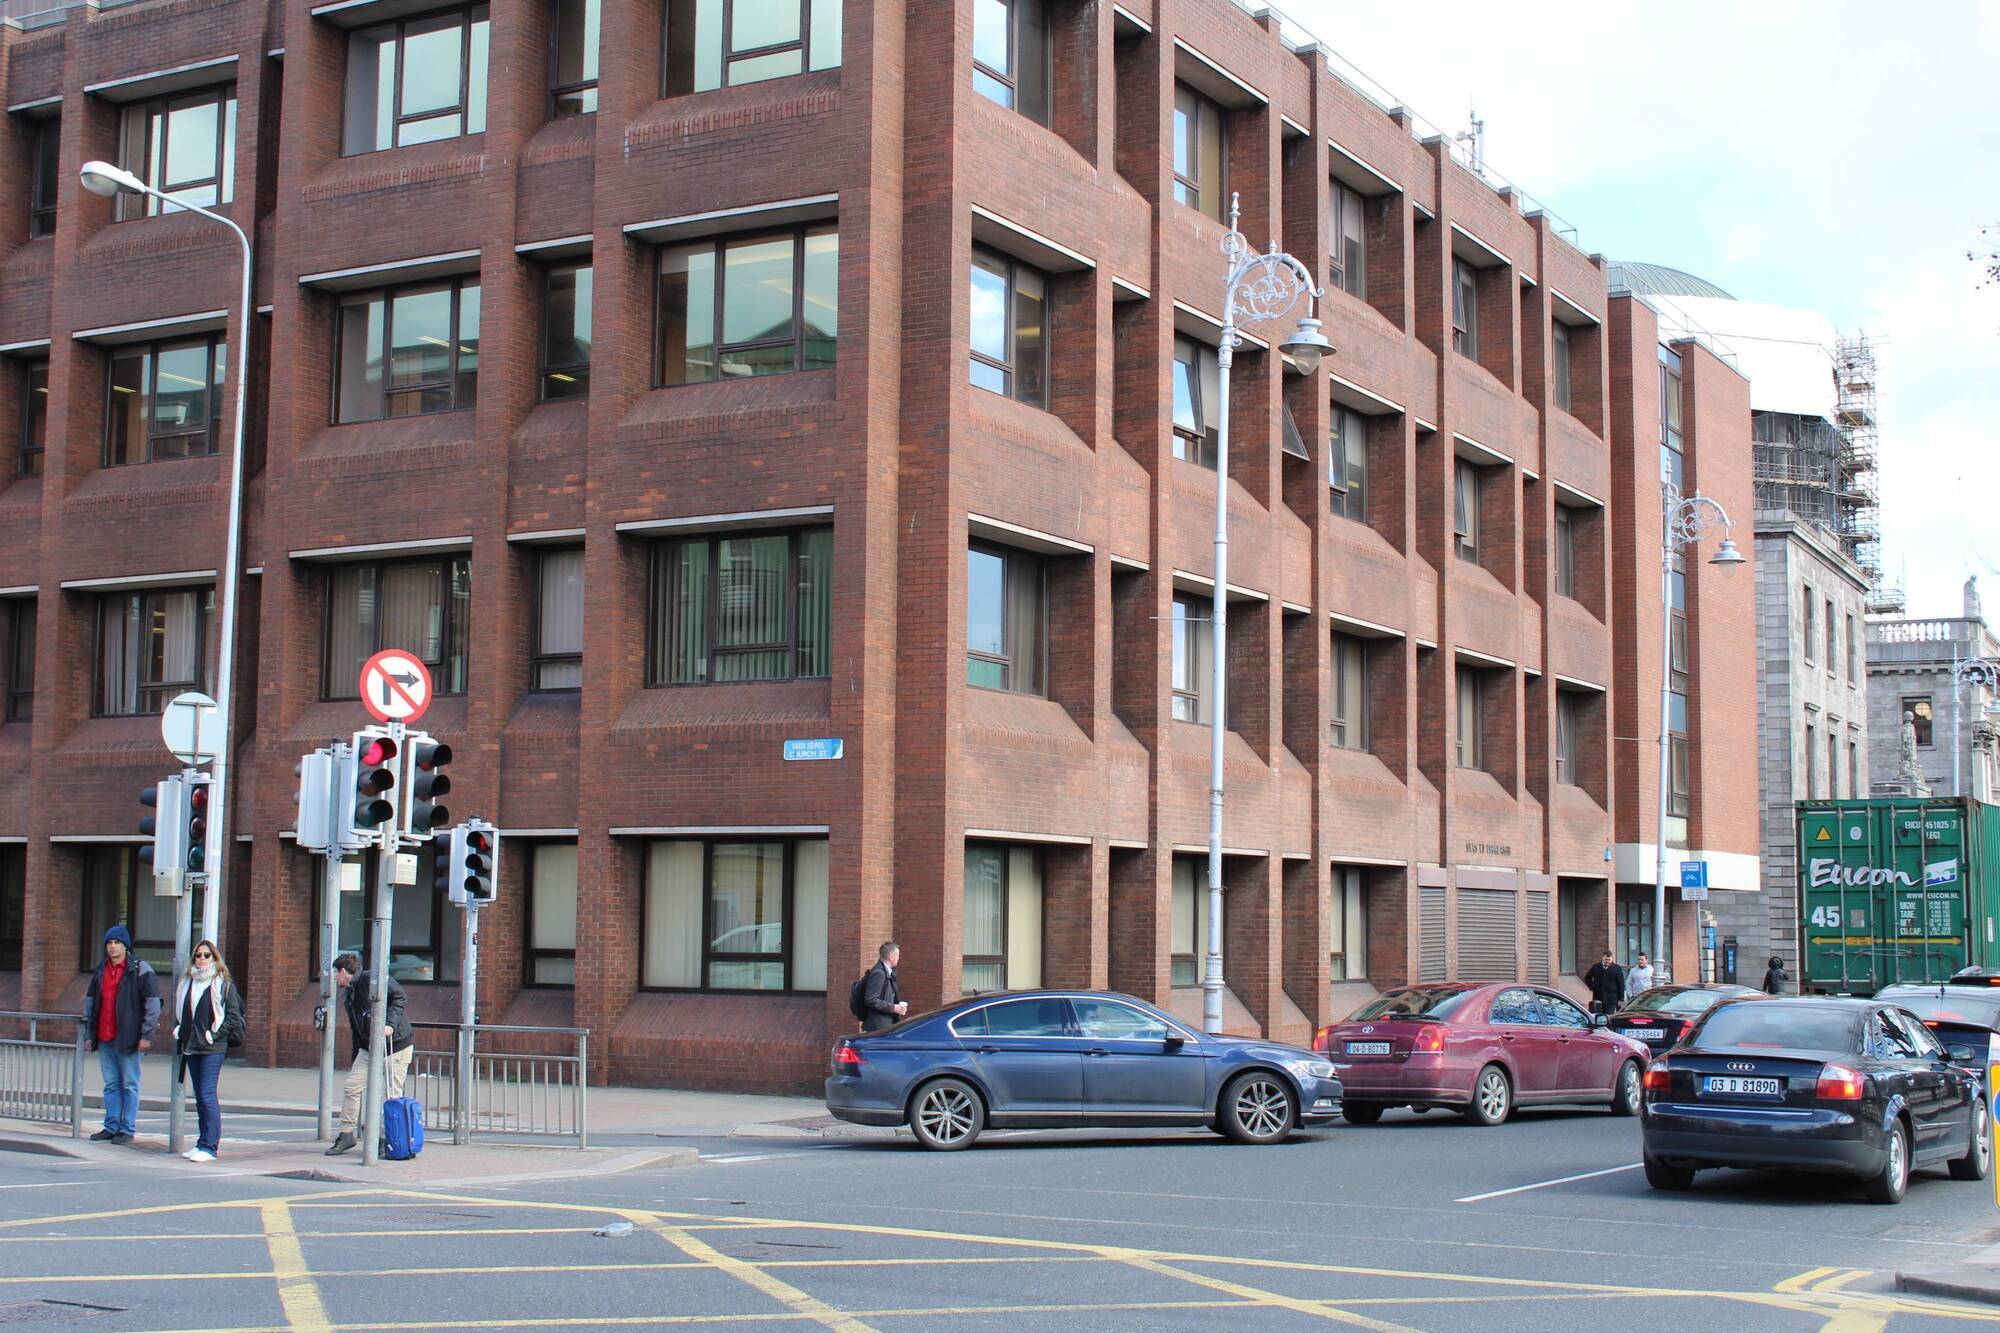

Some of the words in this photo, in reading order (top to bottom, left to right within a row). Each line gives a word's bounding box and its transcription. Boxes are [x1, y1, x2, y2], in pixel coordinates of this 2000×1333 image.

[1810, 857, 1924, 888] Eucon
[1811, 905, 1840, 927] 45
[1711, 1079, 1724, 1091] 03
[1730, 1079, 1737, 1092] D
[1742, 1080, 1776, 1093] 81890
